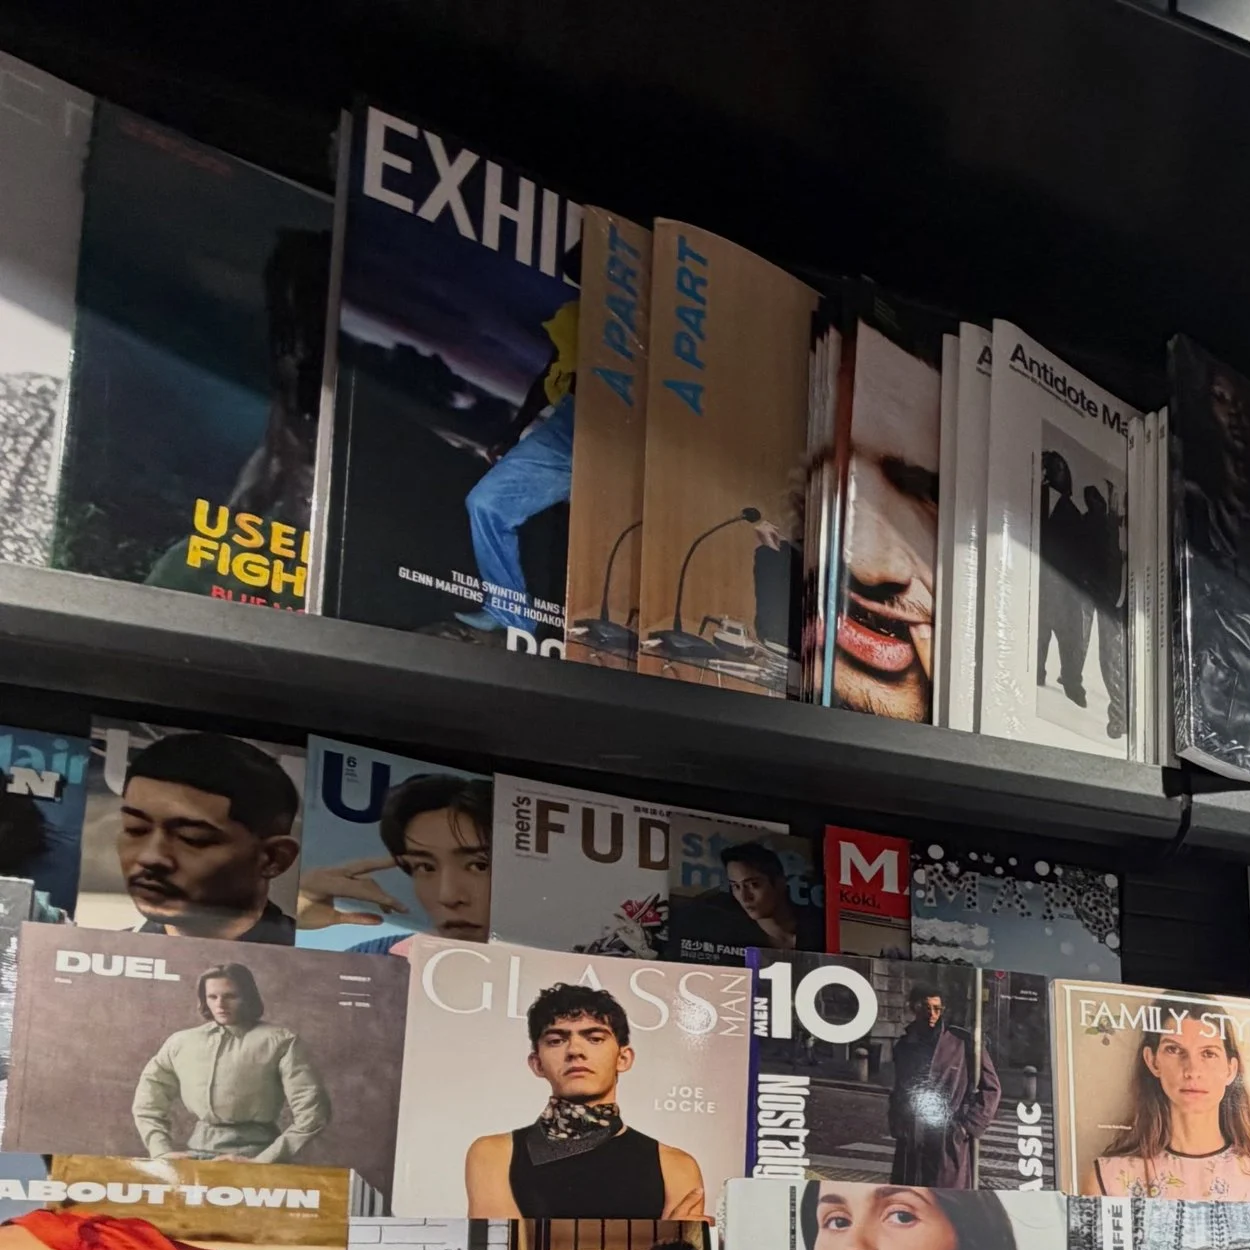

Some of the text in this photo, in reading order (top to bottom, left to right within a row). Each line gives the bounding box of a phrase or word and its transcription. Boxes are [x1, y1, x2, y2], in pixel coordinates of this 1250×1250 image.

[602, 224, 642, 358] PART
[663, 235, 709, 417] A PART
[1010, 344, 1099, 419] Antidote
[398, 566, 433, 589] GLENN
[435, 577, 484, 603] MARTENS
[491, 595, 522, 617] ELLEN
[451, 570, 561, 615] TILDA SWINTON HANS
[515, 795, 532, 852] men's
[839, 840, 909, 895] M
[55, 949, 181, 982] DUEL
[719, 972, 747, 1037] MAN
[753, 996, 770, 1038] MEN
[758, 961, 879, 1045] 10
[1079, 1000, 1190, 1037] FAMILY
[654, 1099, 717, 1115] LOCKE
[667, 1086, 704, 1100] JOE
[0, 1180, 320, 1210] ABOUT TOWN
